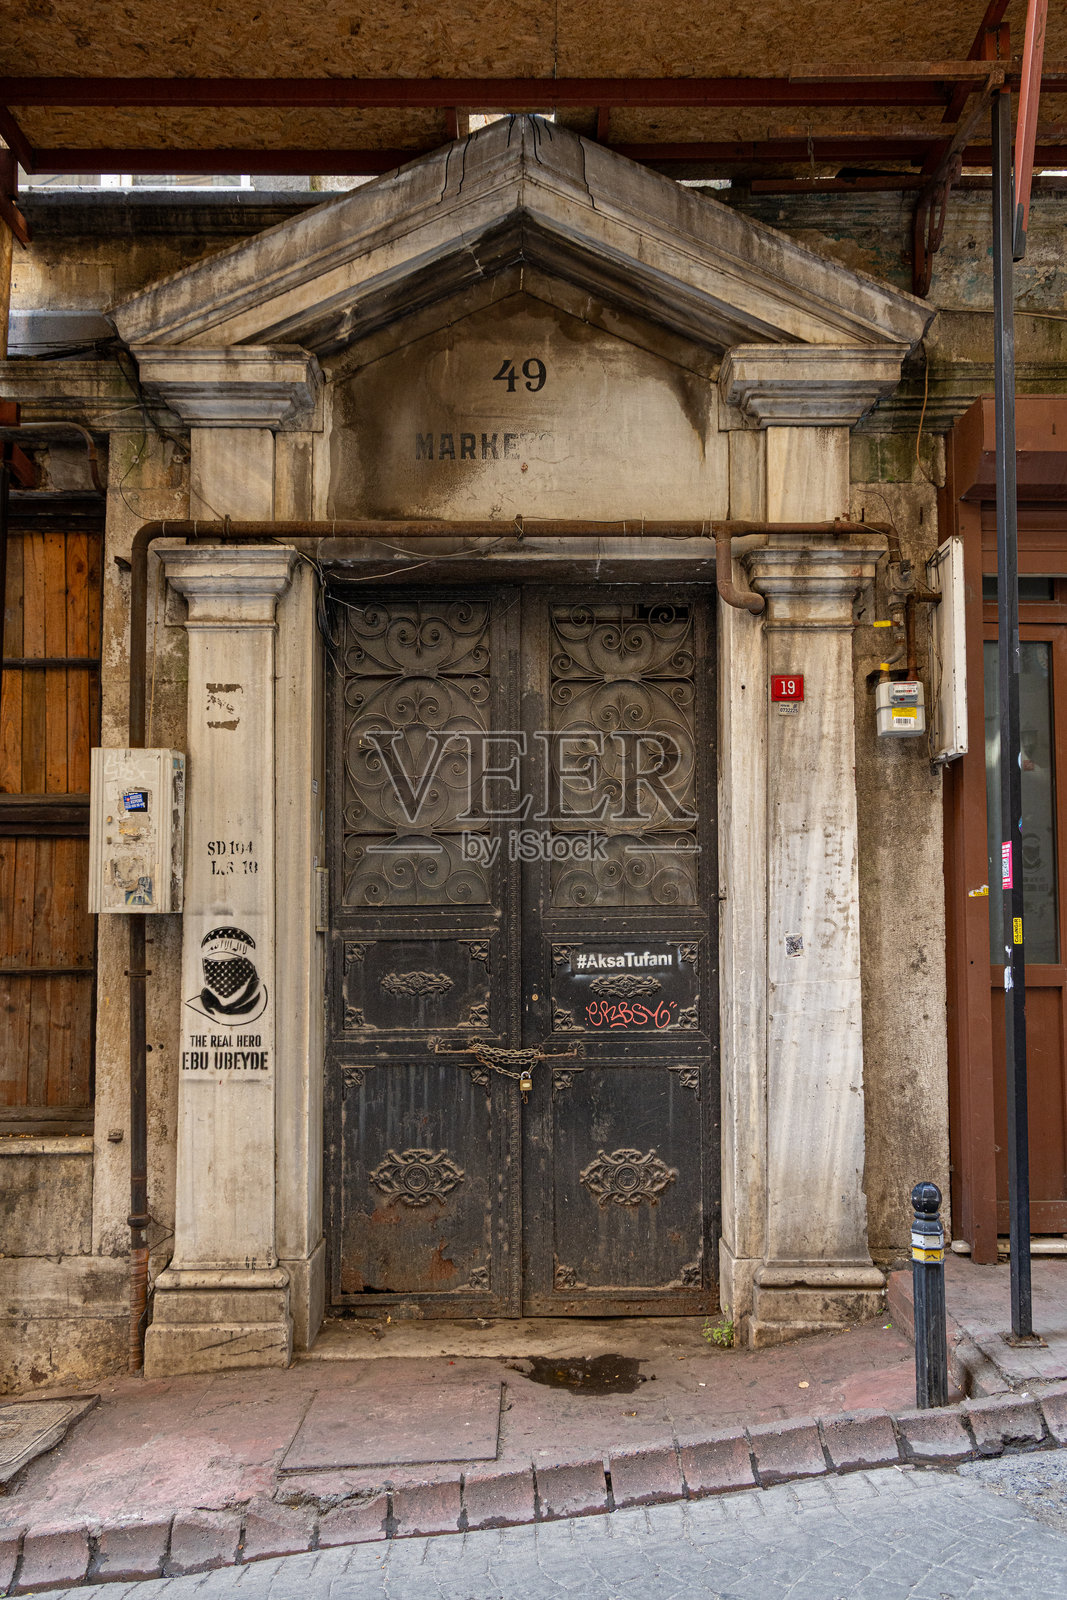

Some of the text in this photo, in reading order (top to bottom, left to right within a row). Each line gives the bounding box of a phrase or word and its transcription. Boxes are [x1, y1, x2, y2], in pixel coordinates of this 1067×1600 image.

[493, 358, 547, 392] 49
[781, 680, 796, 695] 19
[190, 1034, 262, 1048] THE REAL HERO
[182, 1051, 269, 1070] EBU UBEYDE
